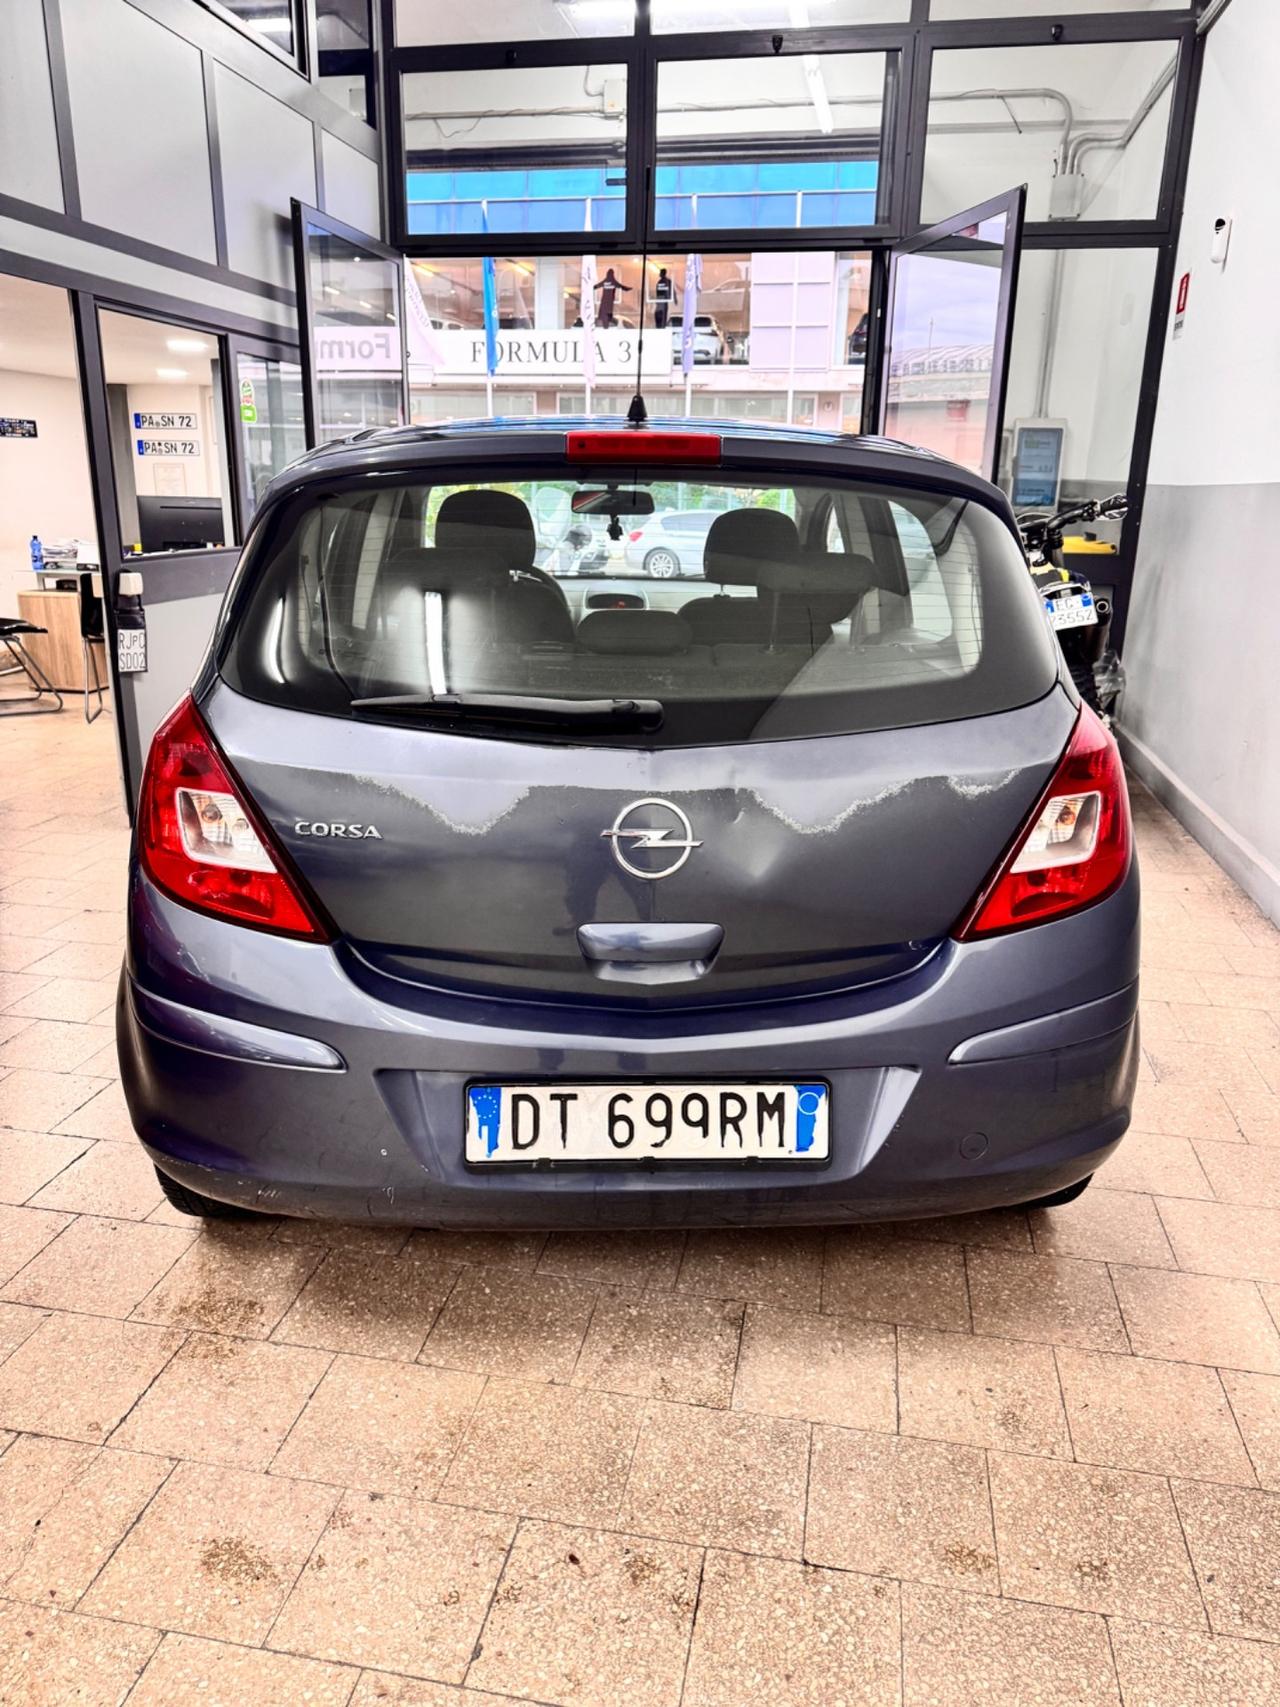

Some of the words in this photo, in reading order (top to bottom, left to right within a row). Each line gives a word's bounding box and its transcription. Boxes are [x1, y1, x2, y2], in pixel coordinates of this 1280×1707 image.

[618, 340, 632, 362] 3
[141, 415, 154, 426] PA
[160, 414, 175, 427] SN
[178, 415, 192, 427] 72
[144, 442, 157, 453] PA
[164, 442, 178, 454] SN
[181, 442, 195, 454] 72
[294, 821, 383, 840] CORSA
[511, 1093, 578, 1151] DT
[607, 1092, 786, 1149] 699RM
